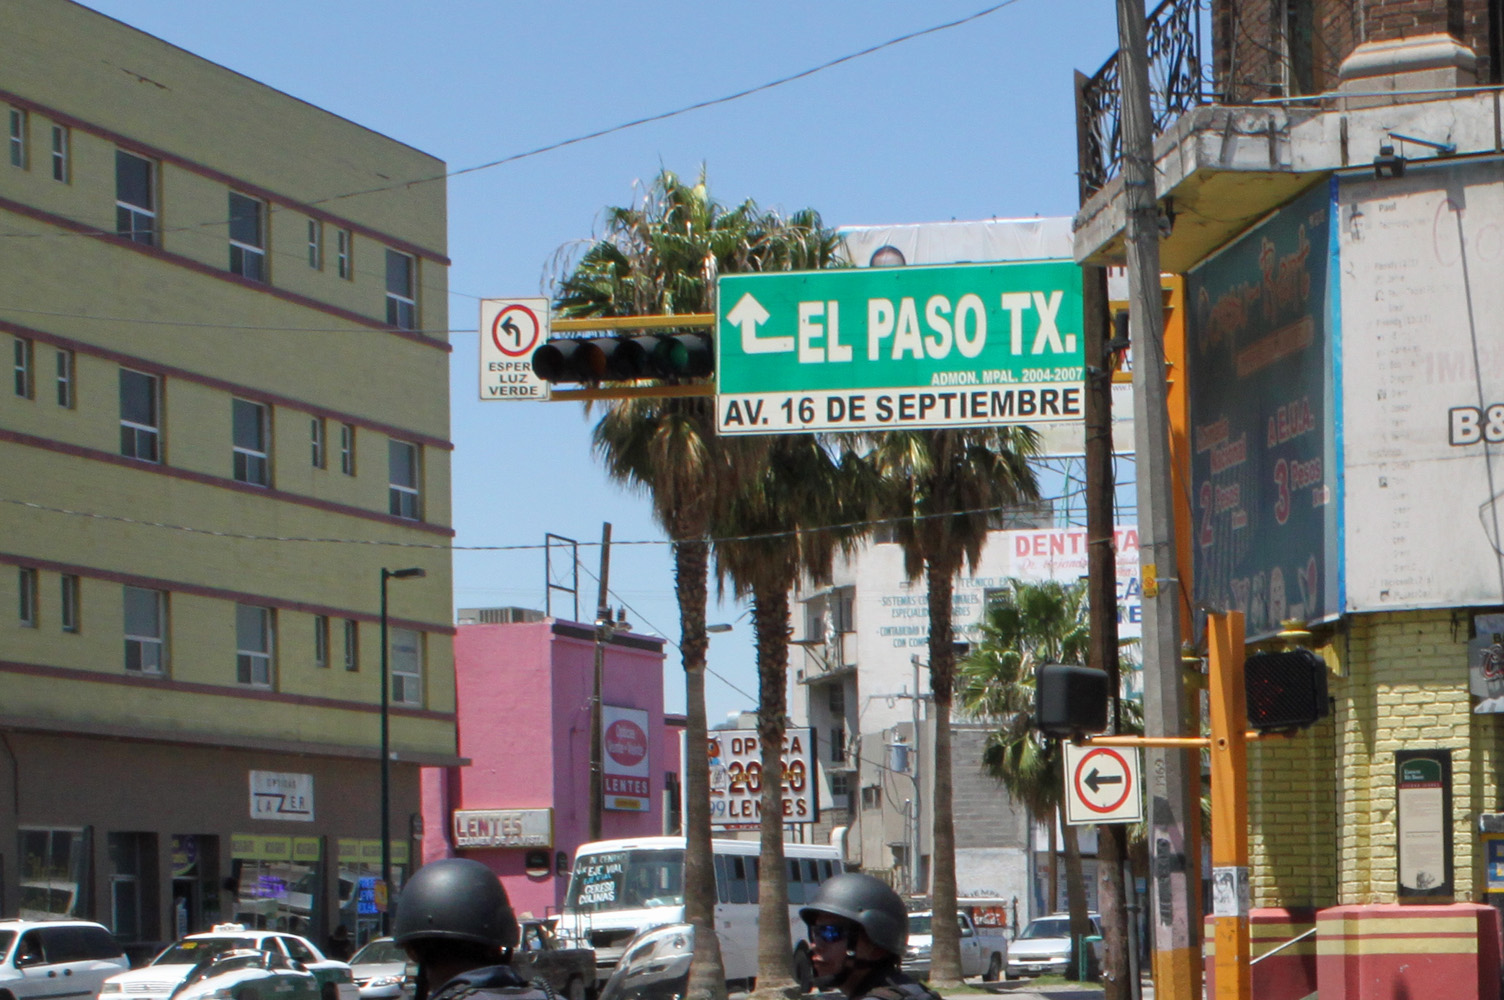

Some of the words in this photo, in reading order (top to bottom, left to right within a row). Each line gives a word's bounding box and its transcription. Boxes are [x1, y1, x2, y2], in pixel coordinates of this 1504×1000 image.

[798, 300, 853, 364] EL
[867, 292, 987, 361] PASO
[1001, 290, 1077, 356] TX.
[488, 362, 532, 372] ESPER
[931, 371, 979, 386] ADMON.
[982, 369, 1019, 385] MPAL.
[1021, 367, 1083, 383] 2004-2007
[499, 374, 528, 383] LUZ
[489, 386, 538, 395] VERDE
[723, 399, 768, 426] AV.
[781, 397, 814, 424] 16
[827, 395, 866, 422] DE
[875, 388, 1081, 422] SEPTIEMBRE
[731, 735, 802, 756] OPCA
[605, 778, 648, 794] LENTES
[456, 816, 522, 837] LENTES
